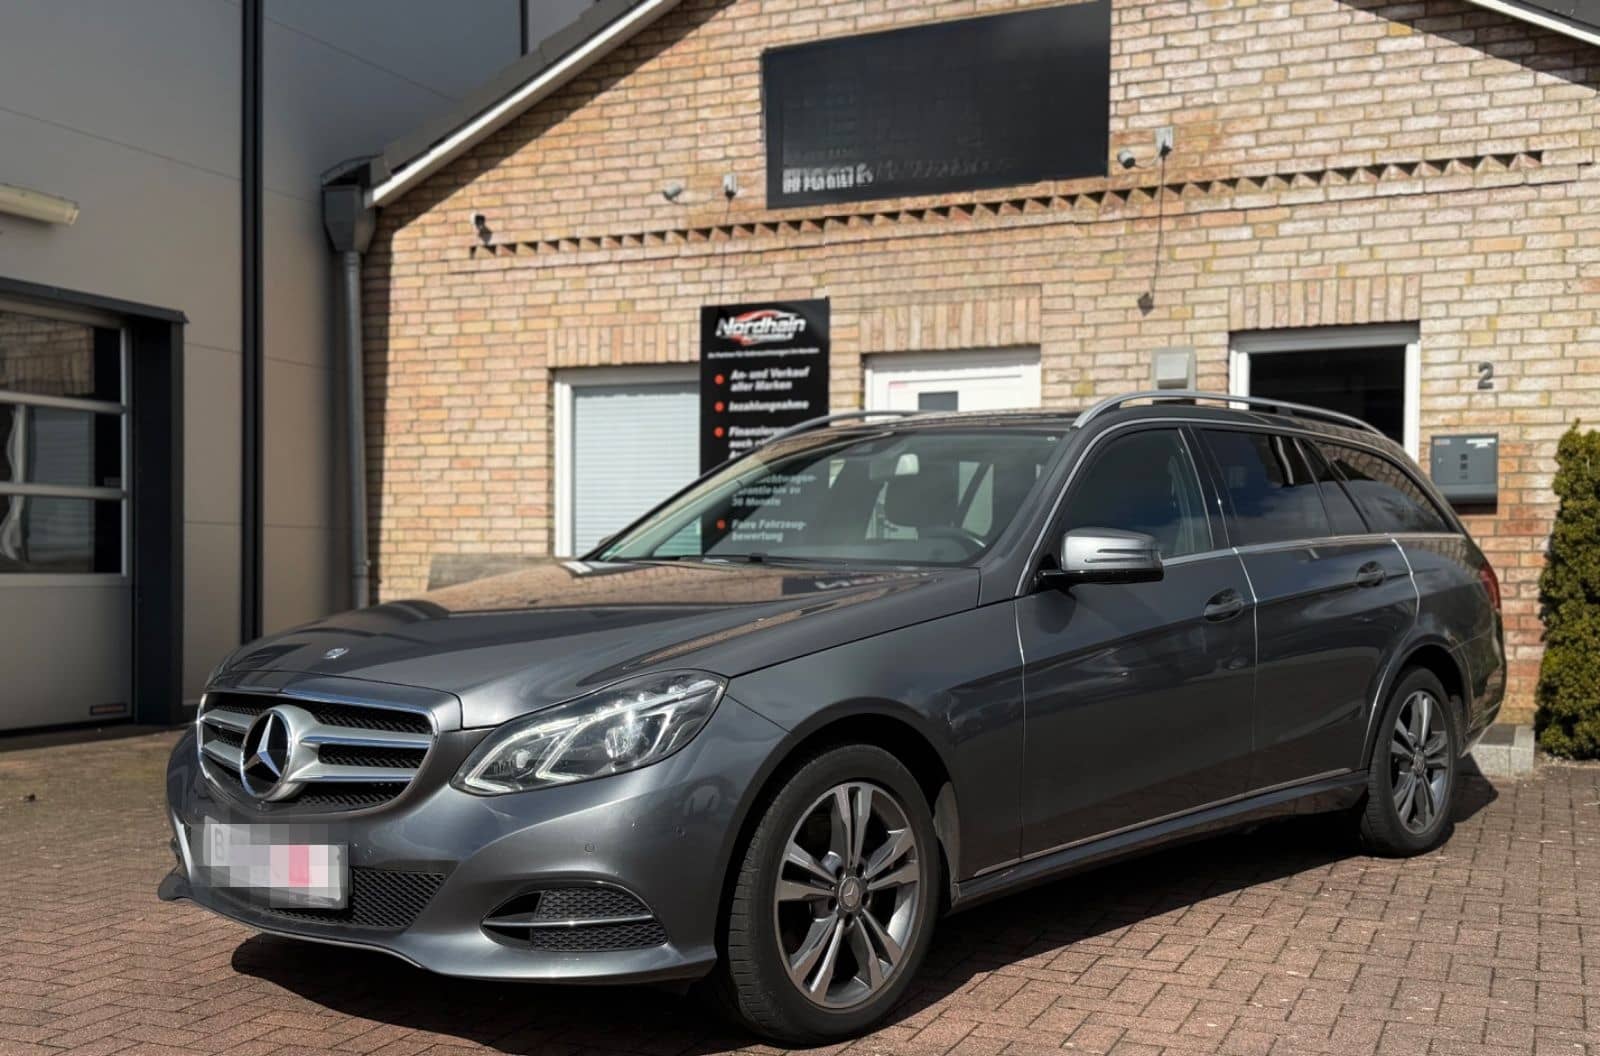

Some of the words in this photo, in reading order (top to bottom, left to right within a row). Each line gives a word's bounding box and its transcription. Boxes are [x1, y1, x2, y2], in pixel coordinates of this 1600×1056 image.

[715, 315, 807, 337] Nordhain
[730, 370, 748, 381] An-
[749, 368, 768, 380] und
[770, 366, 810, 379] Verkauf
[1477, 361, 1494, 390] 2
[730, 381, 753, 392] aller
[755, 380, 792, 391] Marken
